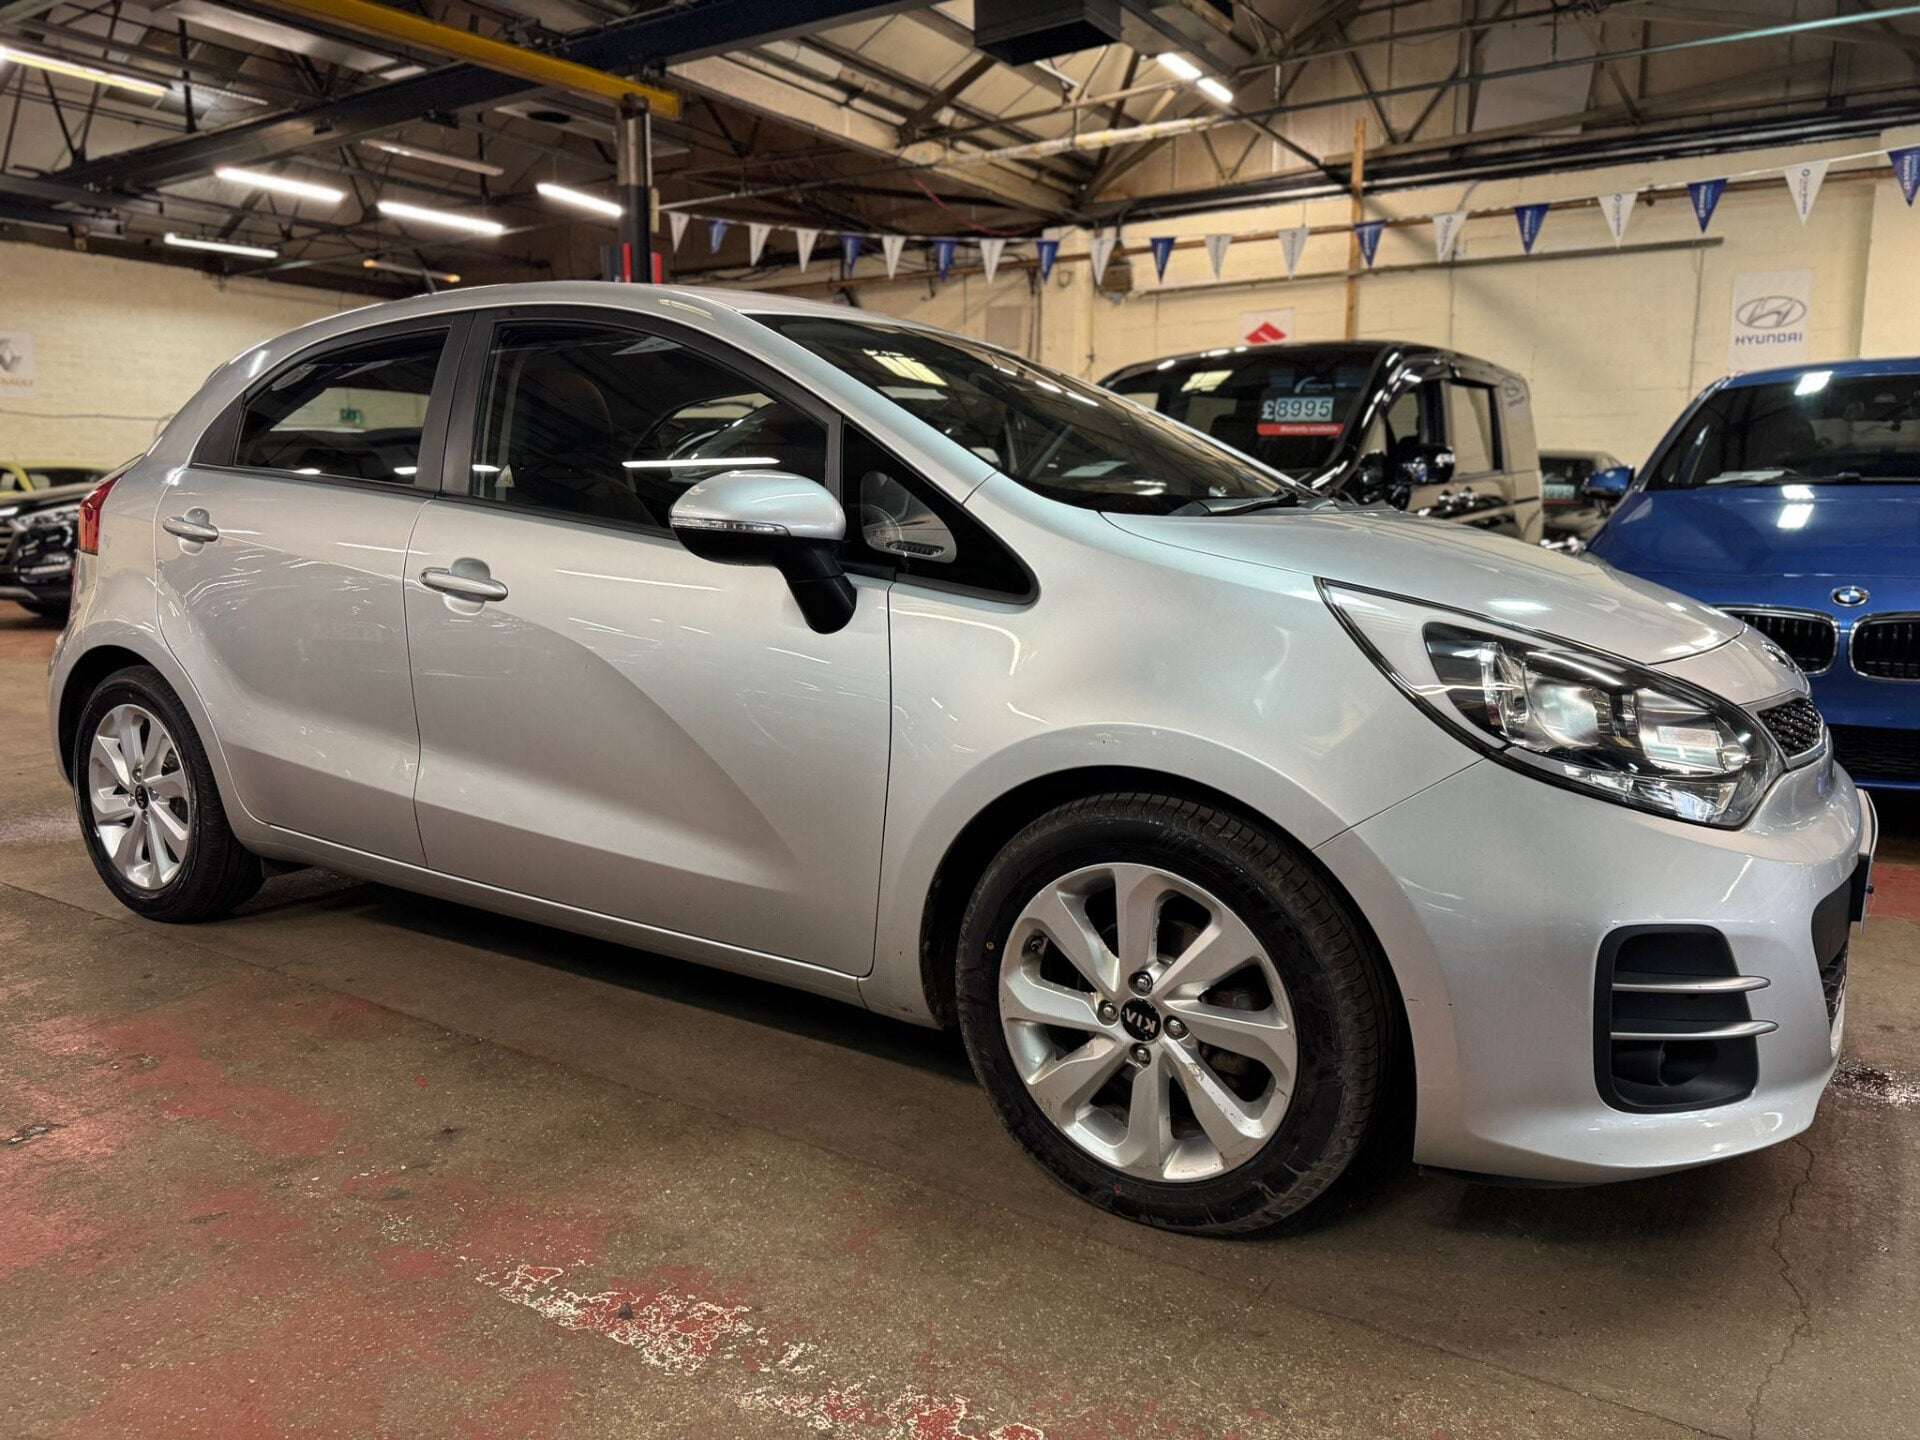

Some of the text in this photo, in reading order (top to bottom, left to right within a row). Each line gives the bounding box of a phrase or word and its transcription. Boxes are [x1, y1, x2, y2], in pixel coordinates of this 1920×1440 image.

[1734, 332, 1803, 345] HYUNDAI
[1262, 400, 1331, 419] £8995
[1125, 1007, 1157, 1033] KIA
